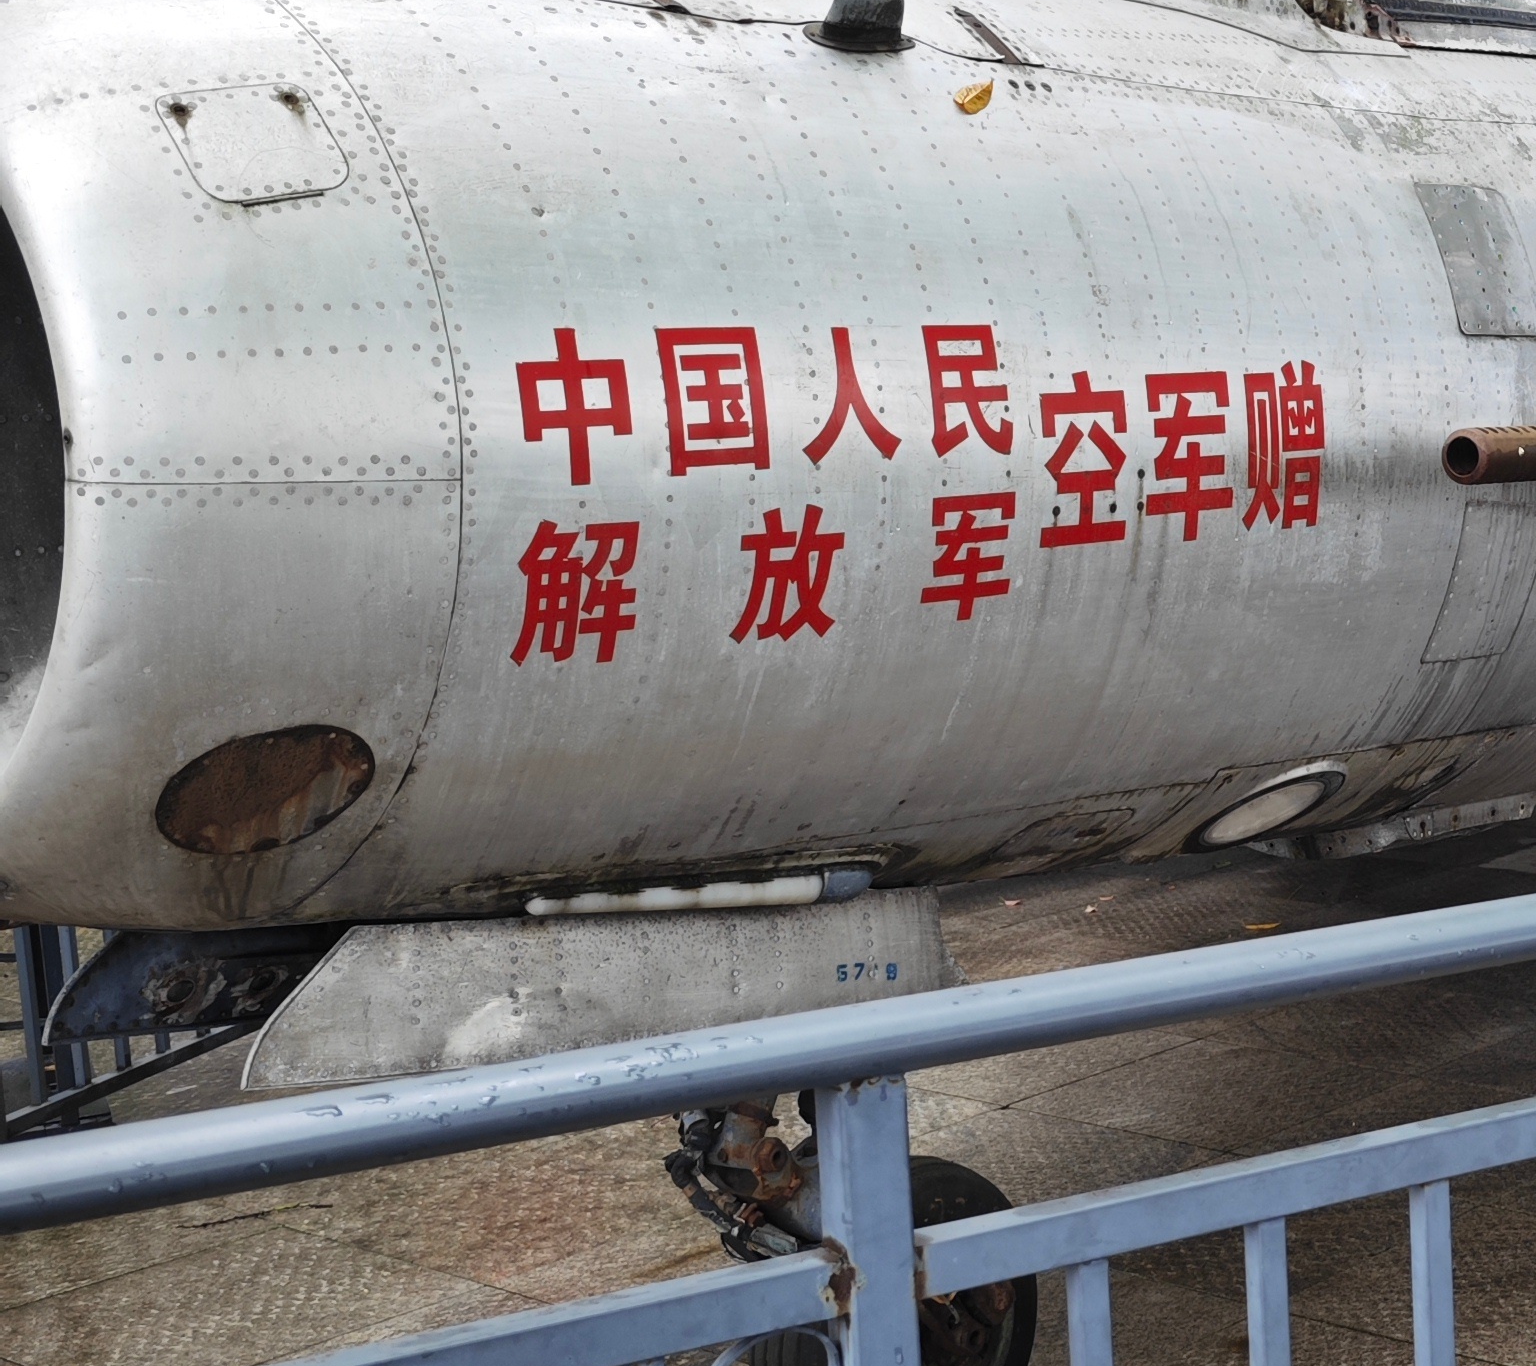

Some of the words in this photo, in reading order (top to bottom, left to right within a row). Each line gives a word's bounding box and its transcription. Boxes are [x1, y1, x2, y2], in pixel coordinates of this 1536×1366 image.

[516, 325, 1014, 485] 中国人民
[1039, 360, 1325, 549] 空军赠
[510, 492, 1016, 665] 解放军
